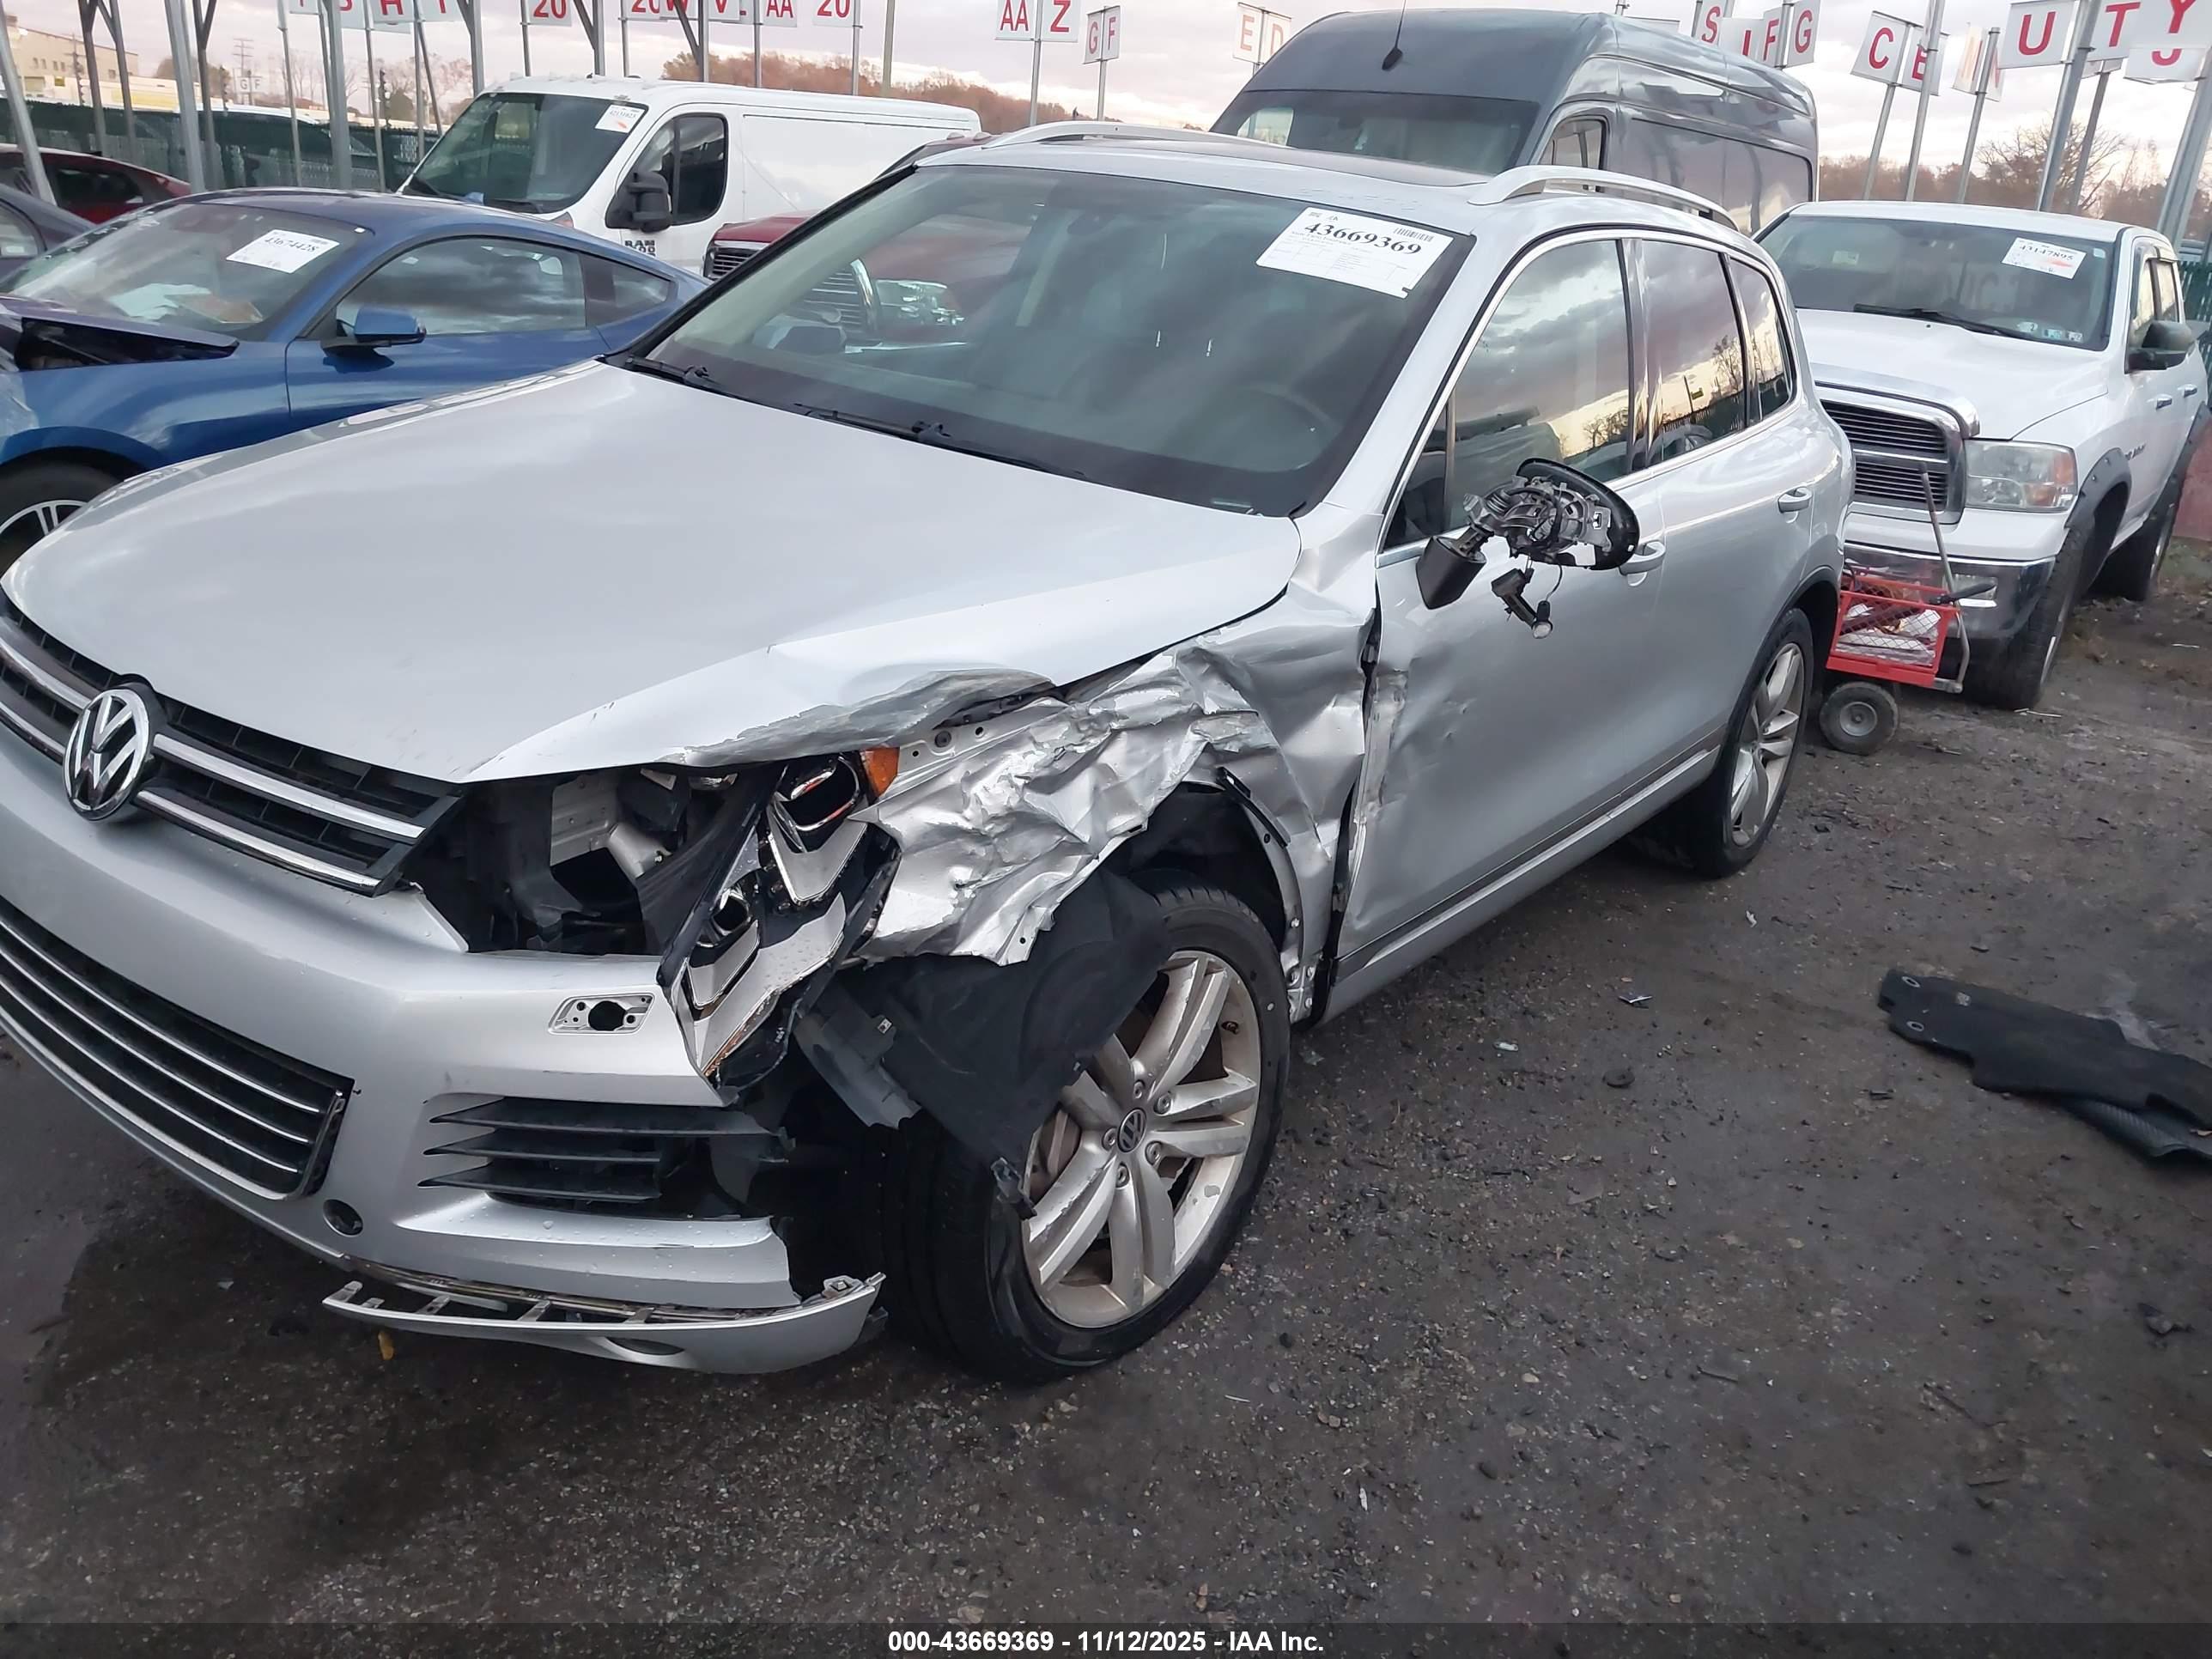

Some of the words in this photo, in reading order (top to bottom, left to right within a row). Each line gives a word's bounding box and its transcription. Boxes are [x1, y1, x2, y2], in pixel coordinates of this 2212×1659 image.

[533, 0, 567, 19] 20
[817, 0, 850, 17] 20
[1000, 0, 1029, 32] AA
[1050, 0, 1071, 33] Z
[1702, 6, 1720, 43] S
[2106, 2, 2141, 47] T
[1089, 21, 1099, 54] G
[1108, 16, 1116, 50] F
[1240, 15, 1255, 51] E
[1763, 18, 1779, 61] F
[1796, 9, 1813, 53] G
[1869, 27, 1894, 70] C
[2019, 11, 2057, 55] U
[1304, 222, 1422, 255] 43669369
